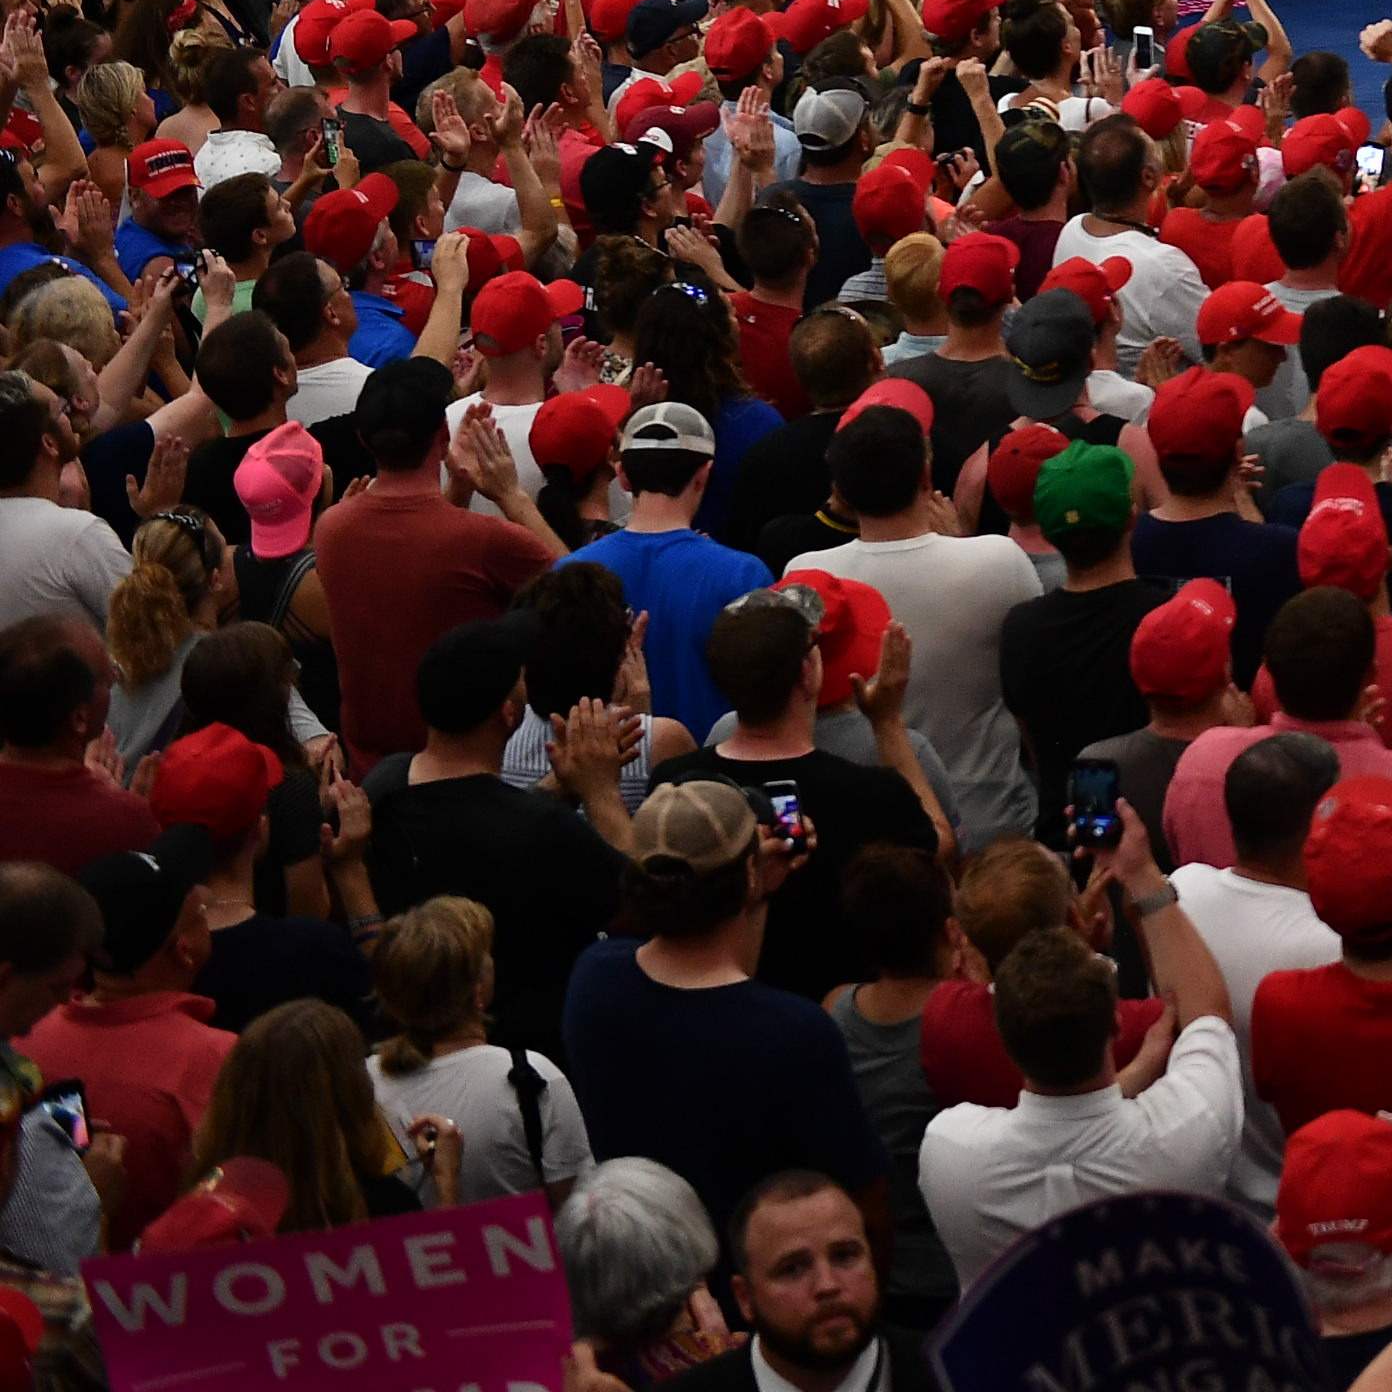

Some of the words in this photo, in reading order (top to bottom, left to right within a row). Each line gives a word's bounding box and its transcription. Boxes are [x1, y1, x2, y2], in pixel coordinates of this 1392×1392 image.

[93, 1216, 558, 1334] WOMEN
[1074, 1239, 1247, 1293] MAKE
[266, 1322, 426, 1379] FOR
